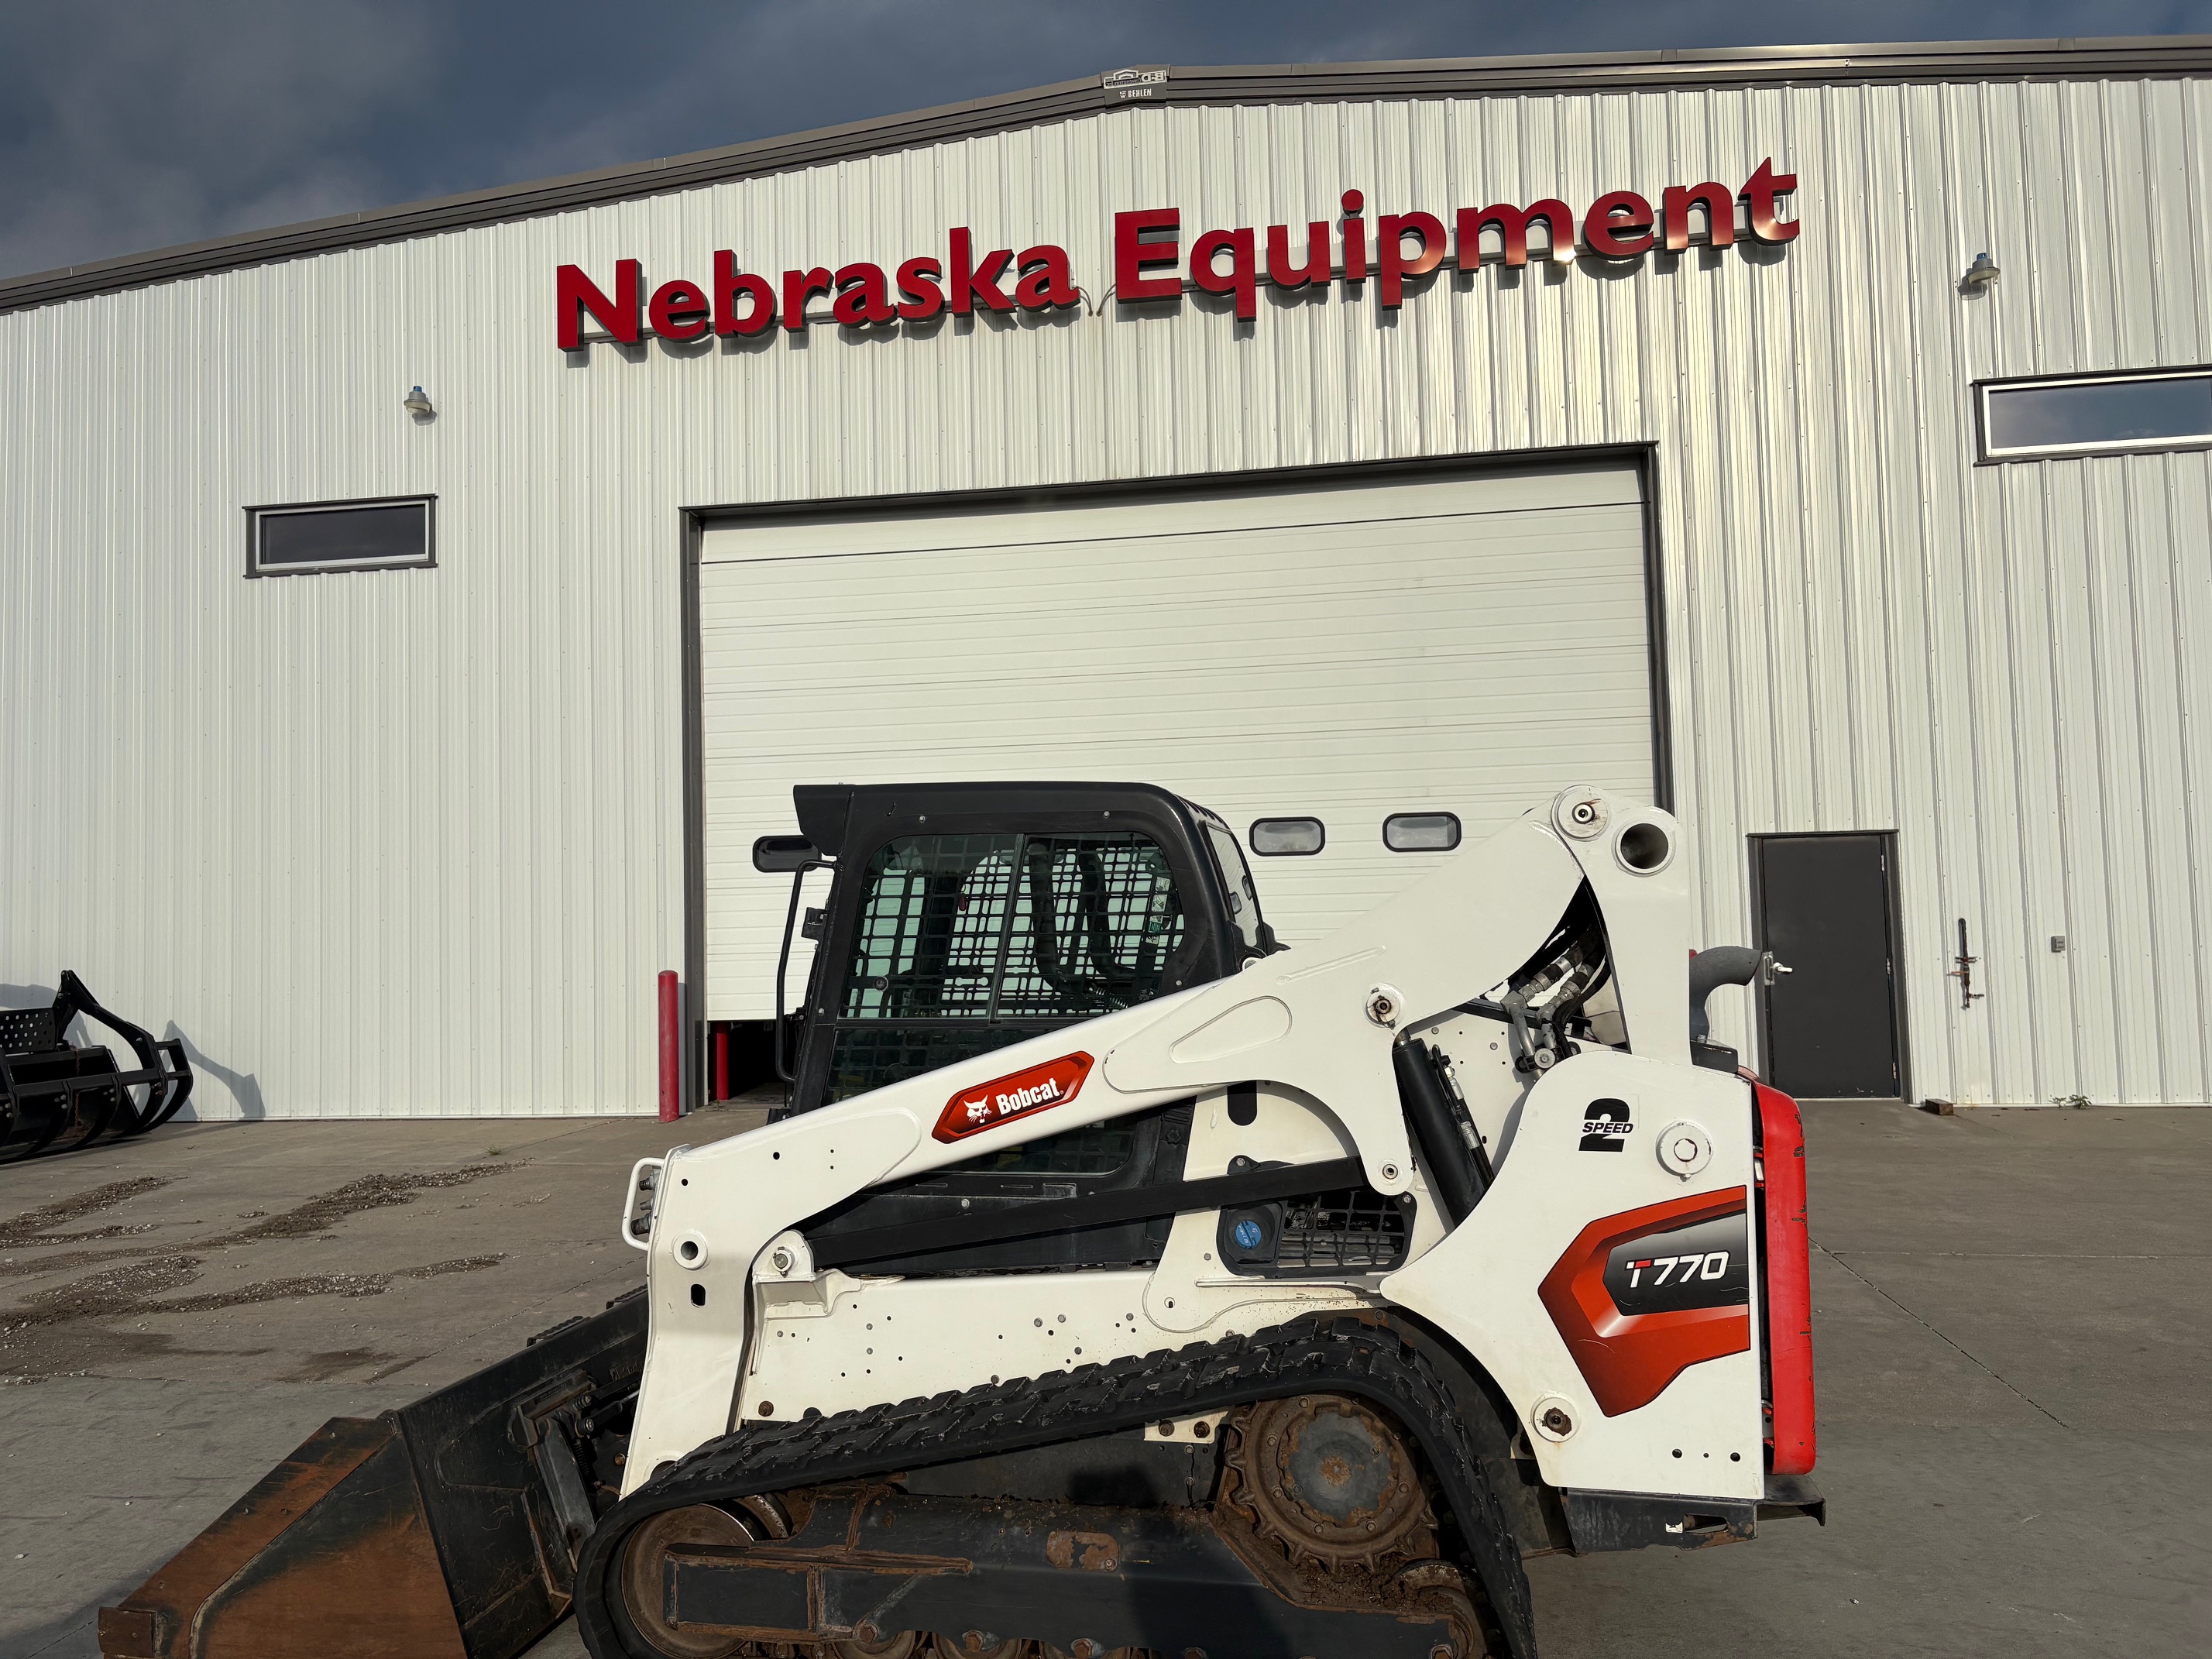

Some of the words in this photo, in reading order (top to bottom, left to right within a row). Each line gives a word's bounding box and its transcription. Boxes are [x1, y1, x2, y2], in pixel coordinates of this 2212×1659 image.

[1128, 88, 1152, 98] BEHLEN
[557, 227, 1080, 352] Nebraska
[1115, 158, 1799, 321] Equipment
[995, 1077, 1060, 1115] Bobcat
[1578, 1097, 1630, 1152] 2
[1582, 1121, 1634, 1134] SPEED
[1626, 1251, 1729, 1288] T770
